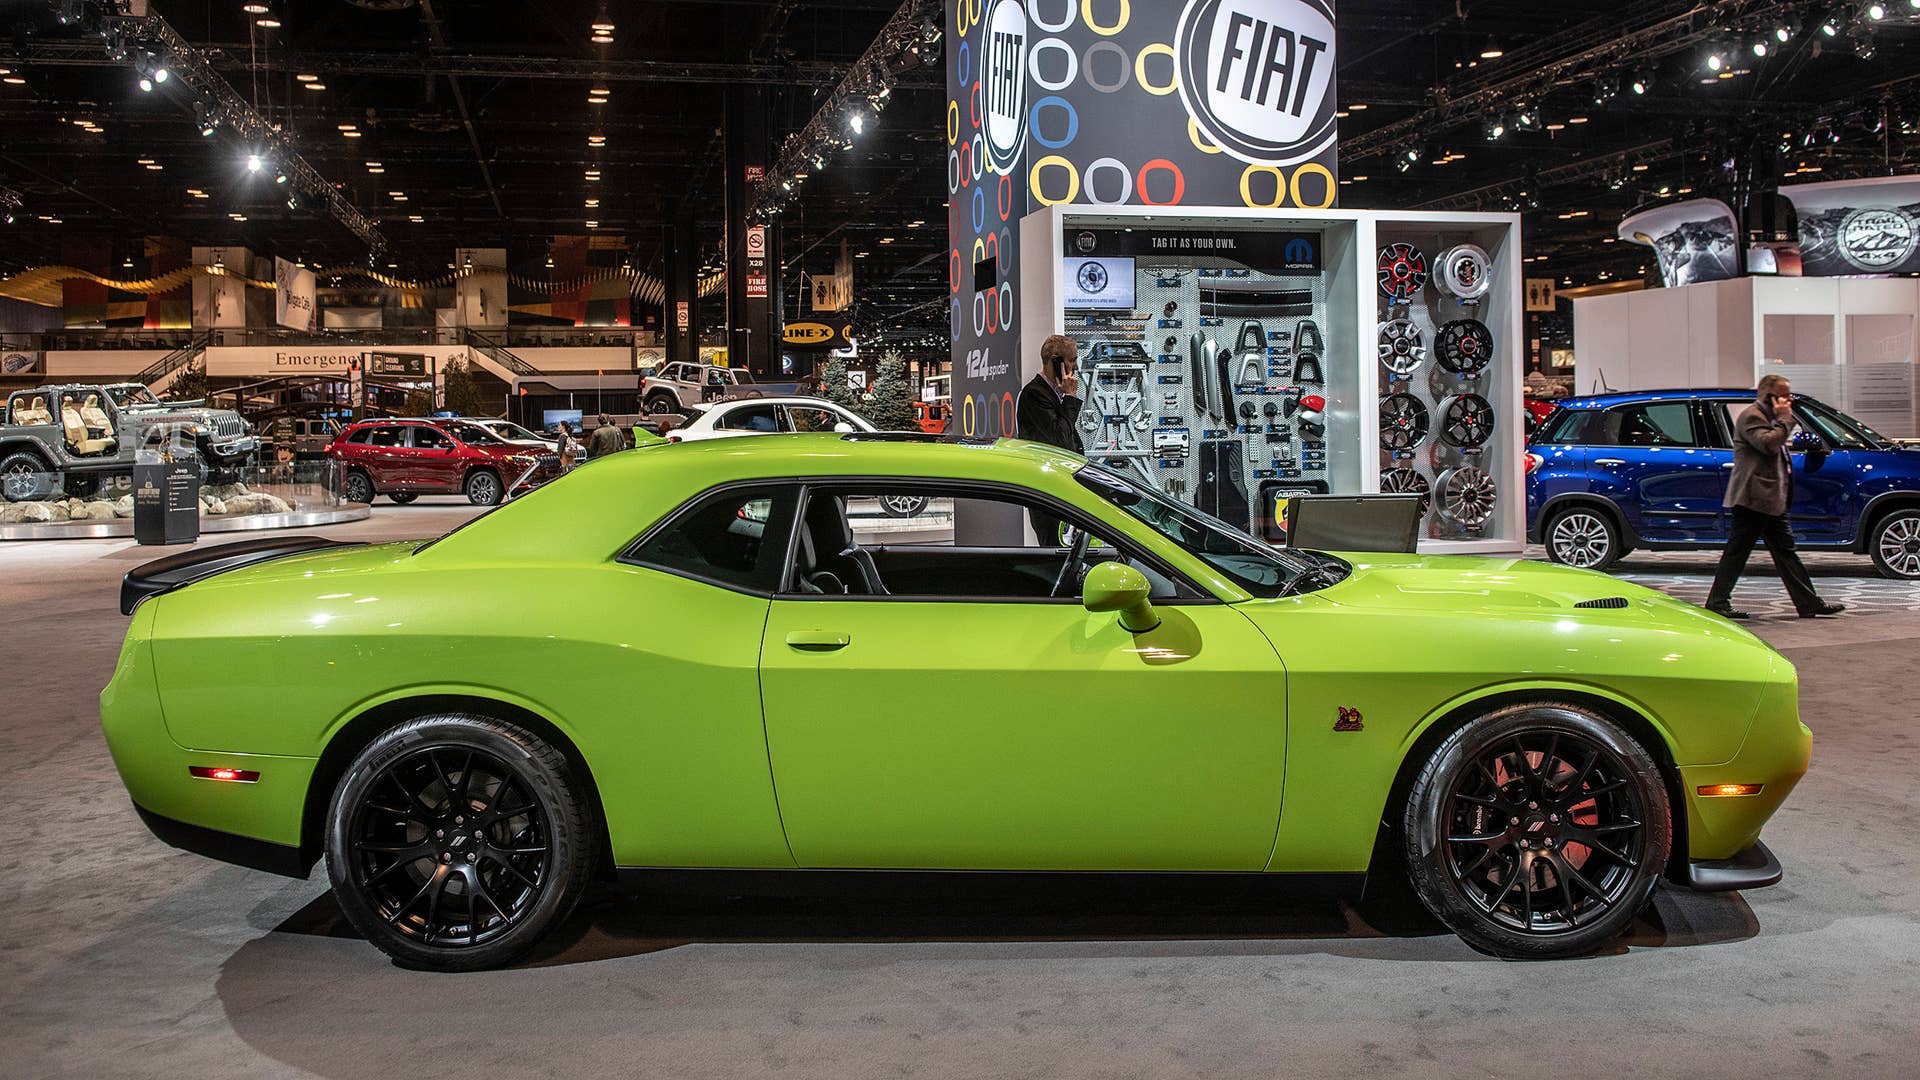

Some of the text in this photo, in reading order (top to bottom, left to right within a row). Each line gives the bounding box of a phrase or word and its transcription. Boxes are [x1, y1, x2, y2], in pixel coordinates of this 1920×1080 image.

[991, 32, 1023, 120] FIAT
[1216, 11, 1327, 118] FIAT
[1152, 237, 1237, 249] TAG IT AS YOUR OWN.
[783, 329, 829, 338] LINE-X
[966, 347, 1009, 381] 124 spider
[707, 391, 738, 403] Jeep
